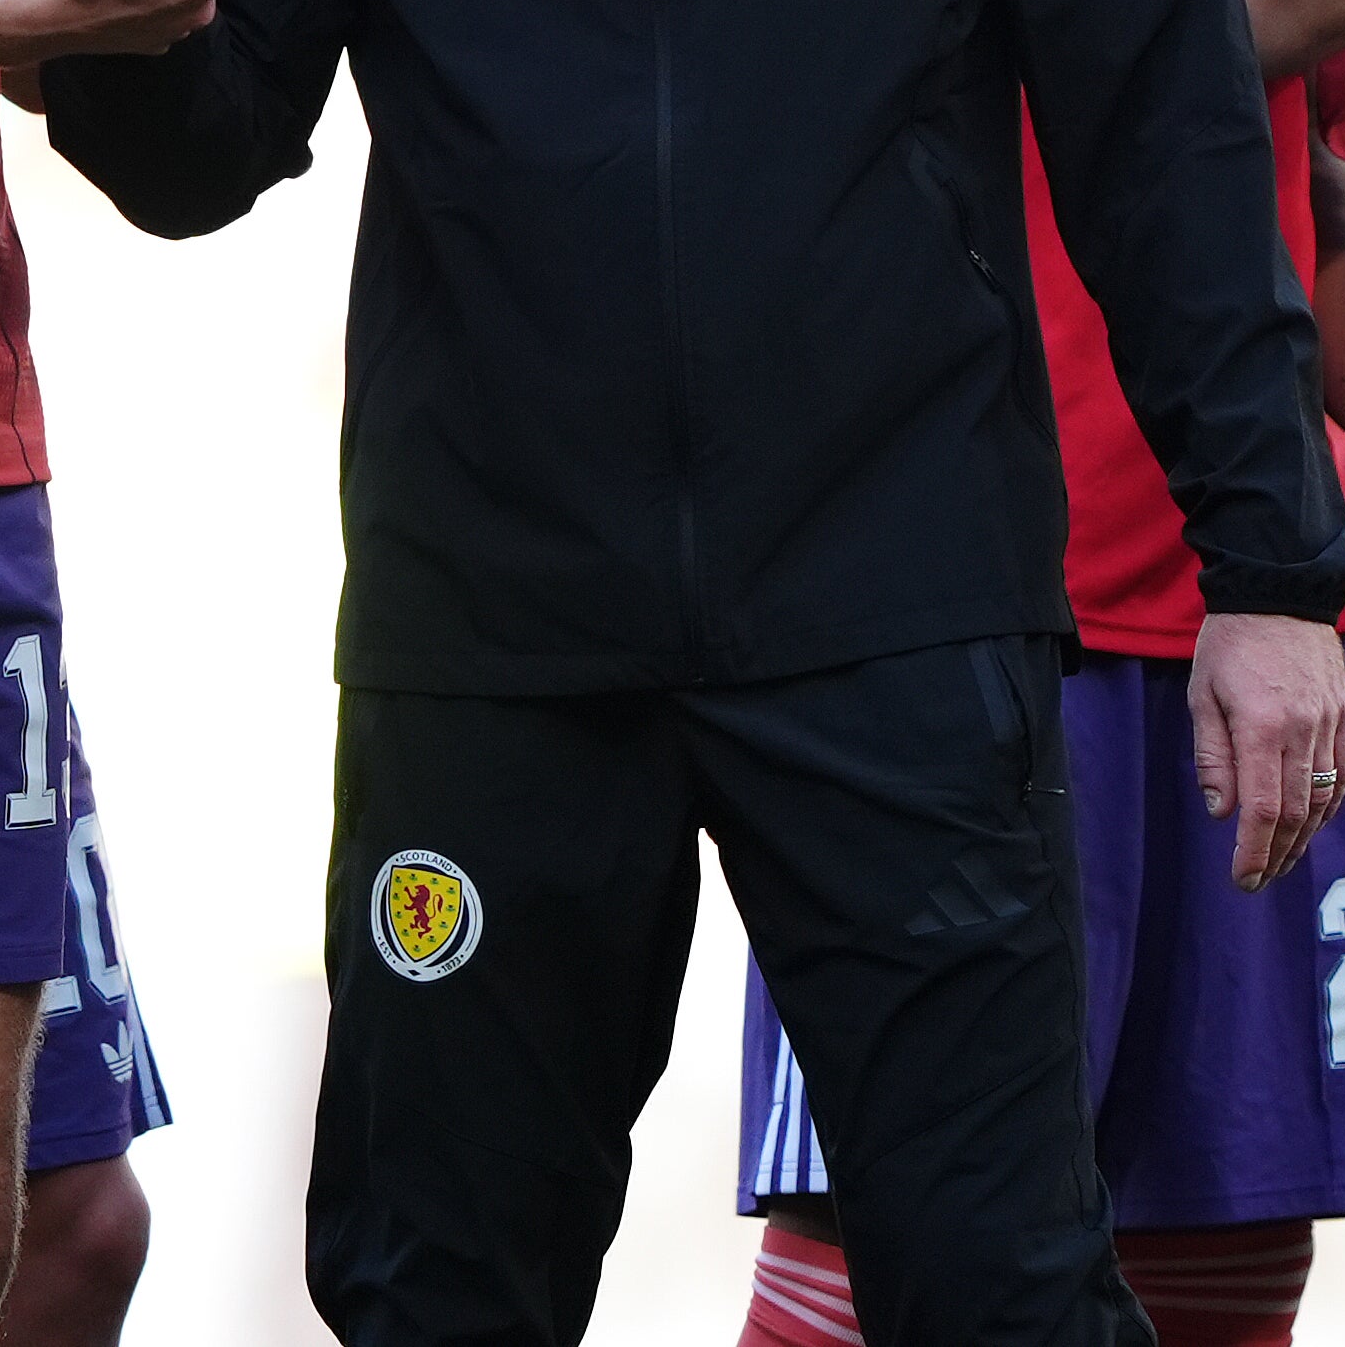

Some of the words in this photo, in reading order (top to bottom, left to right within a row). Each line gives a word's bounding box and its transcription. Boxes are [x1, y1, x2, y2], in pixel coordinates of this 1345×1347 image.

[399, 852, 453, 872] SCOTLAND
[379, 941, 392, 959] EST
[441, 956, 462, 973] 1873
